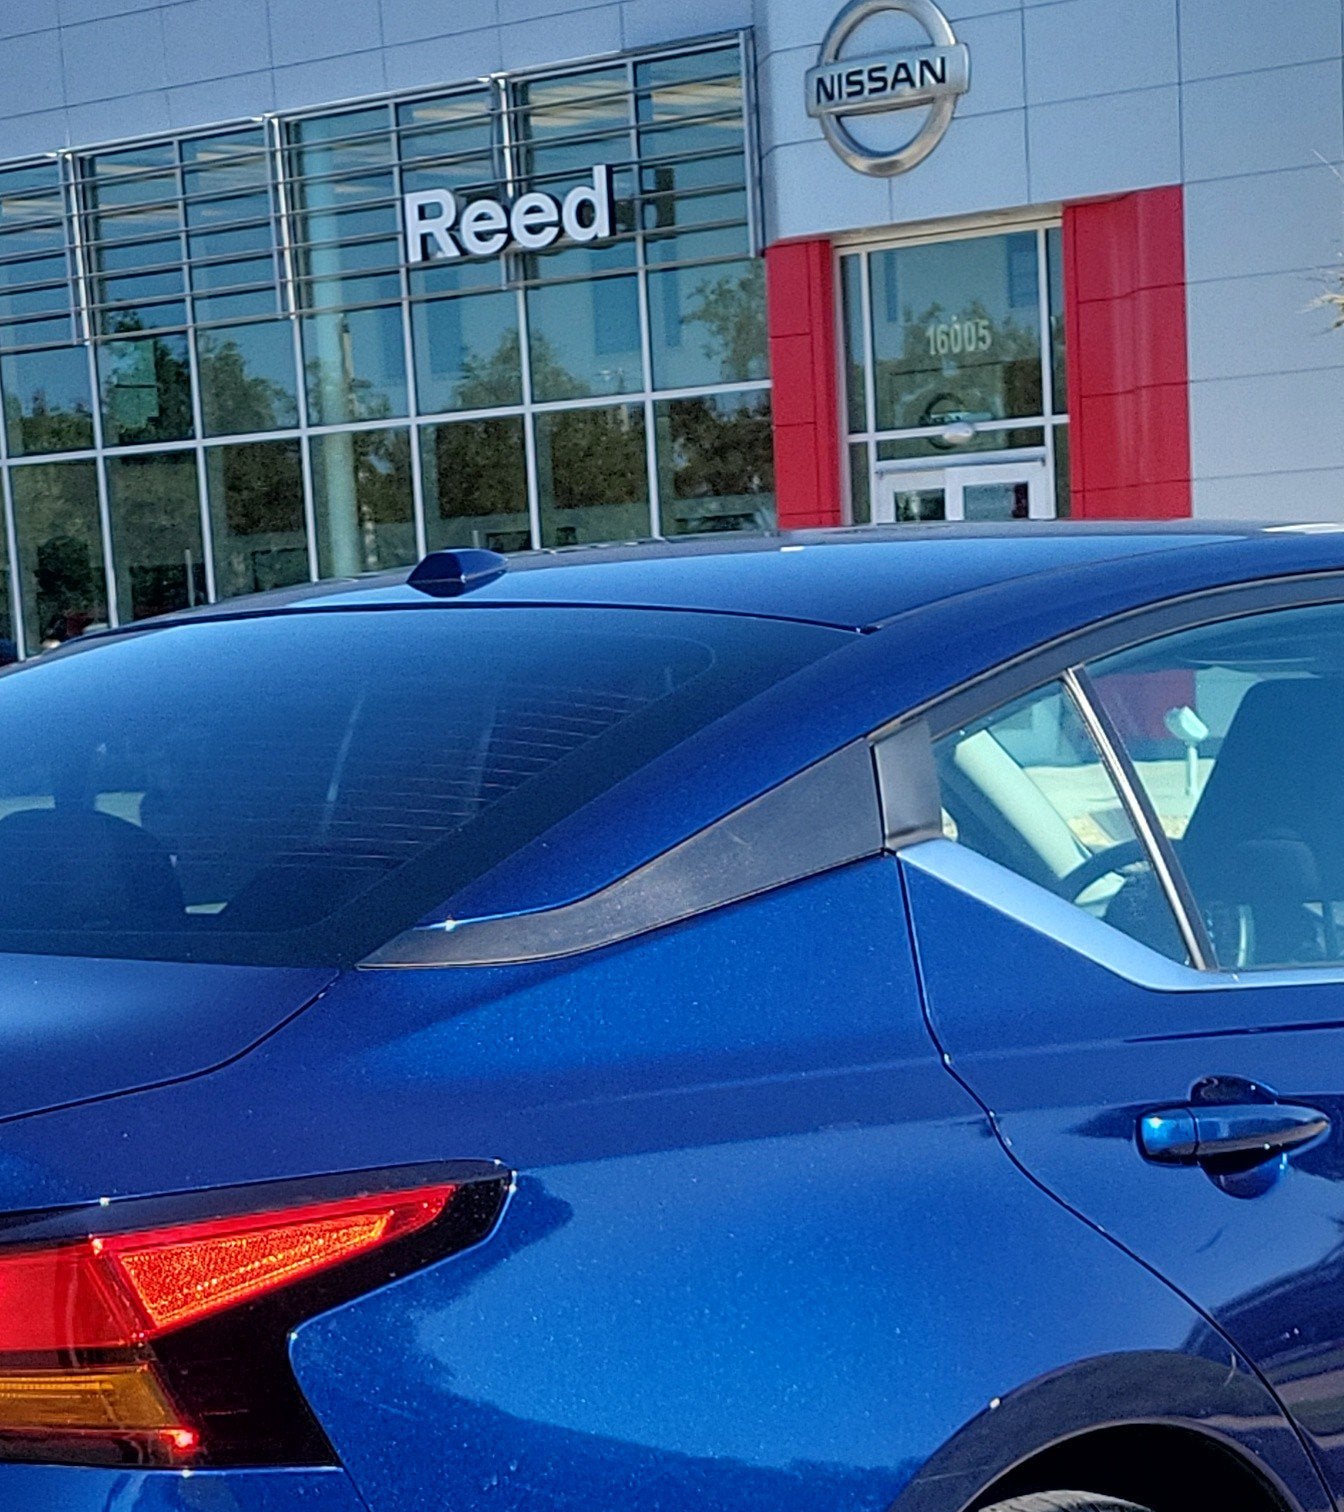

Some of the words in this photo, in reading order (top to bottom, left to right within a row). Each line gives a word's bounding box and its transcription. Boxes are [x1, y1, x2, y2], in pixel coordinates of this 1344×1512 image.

[816, 56, 946, 105] NISSAN
[405, 163, 612, 263] Reed
[925, 318, 993, 356] 16005
